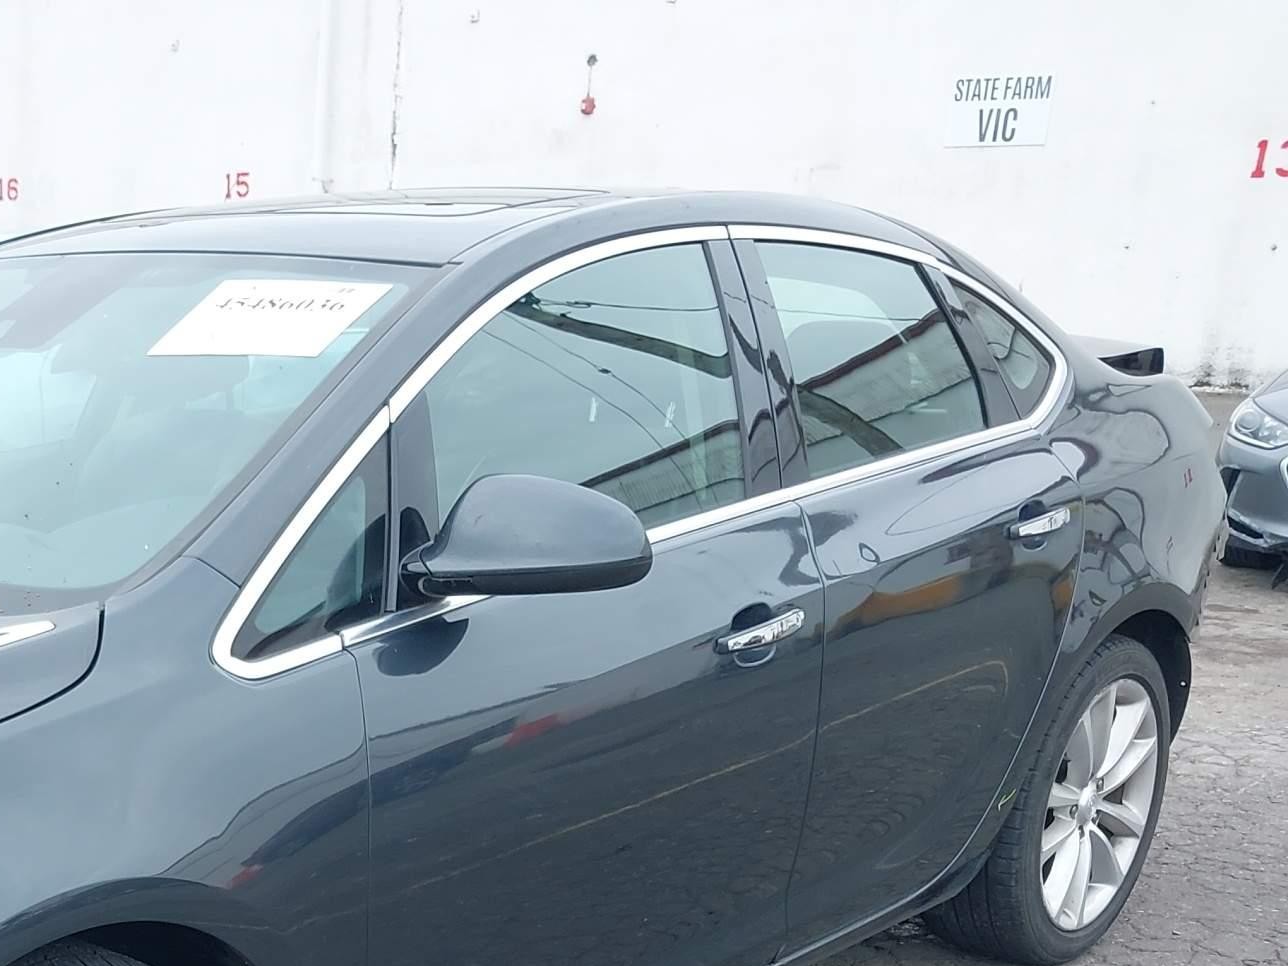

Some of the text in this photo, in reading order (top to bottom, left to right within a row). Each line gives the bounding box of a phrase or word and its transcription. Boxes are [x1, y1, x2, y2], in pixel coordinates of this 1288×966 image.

[954, 75, 1052, 102] STATE FARM
[978, 107, 1018, 143] VIC
[225, 171, 250, 199] 15
